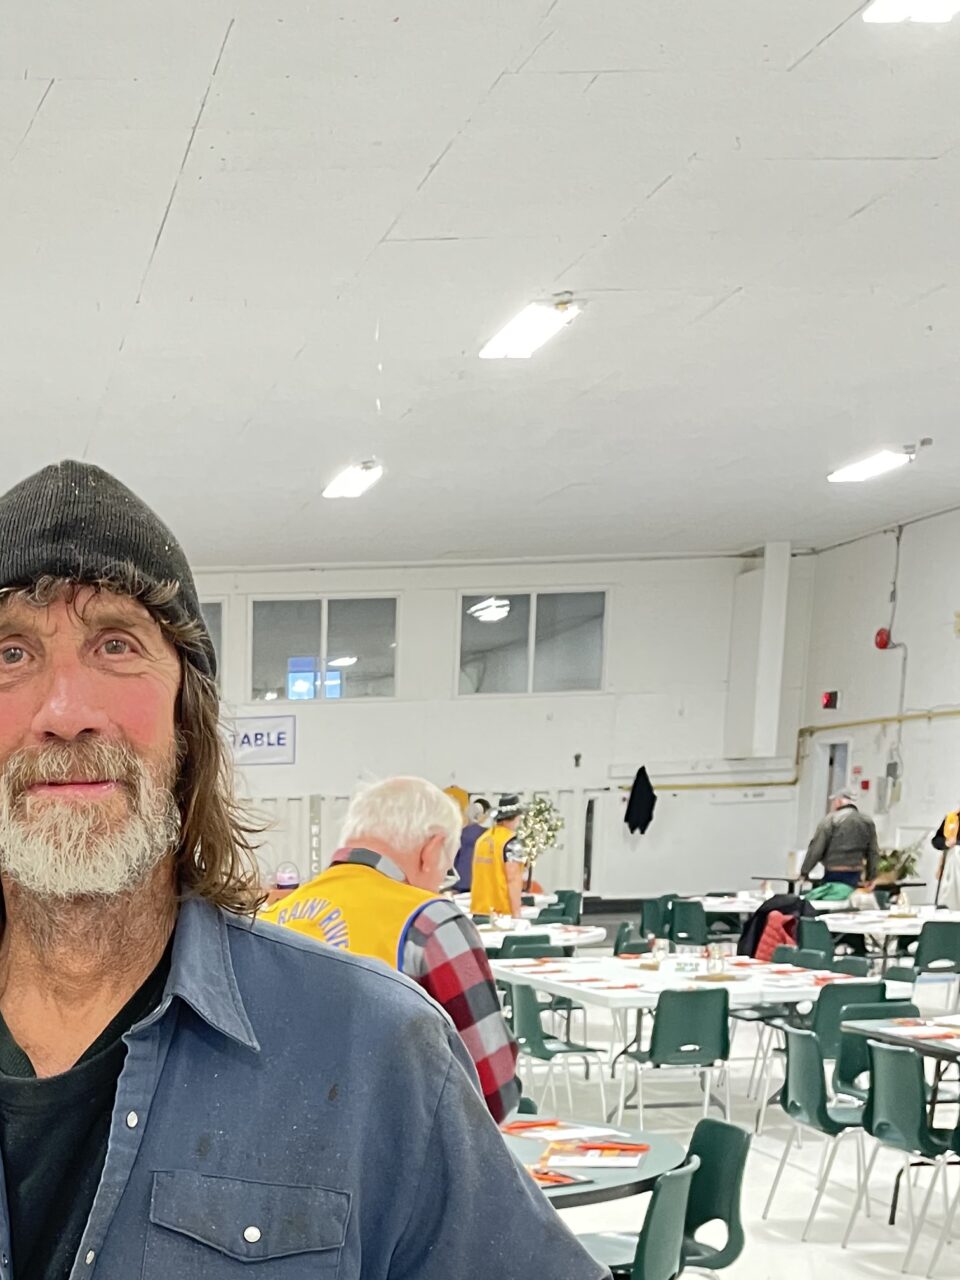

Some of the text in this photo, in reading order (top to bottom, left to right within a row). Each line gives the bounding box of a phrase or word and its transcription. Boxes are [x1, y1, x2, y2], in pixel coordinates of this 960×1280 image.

[311, 824, 320, 873] WELC
[278, 898, 349, 949] RAINY RIVE
